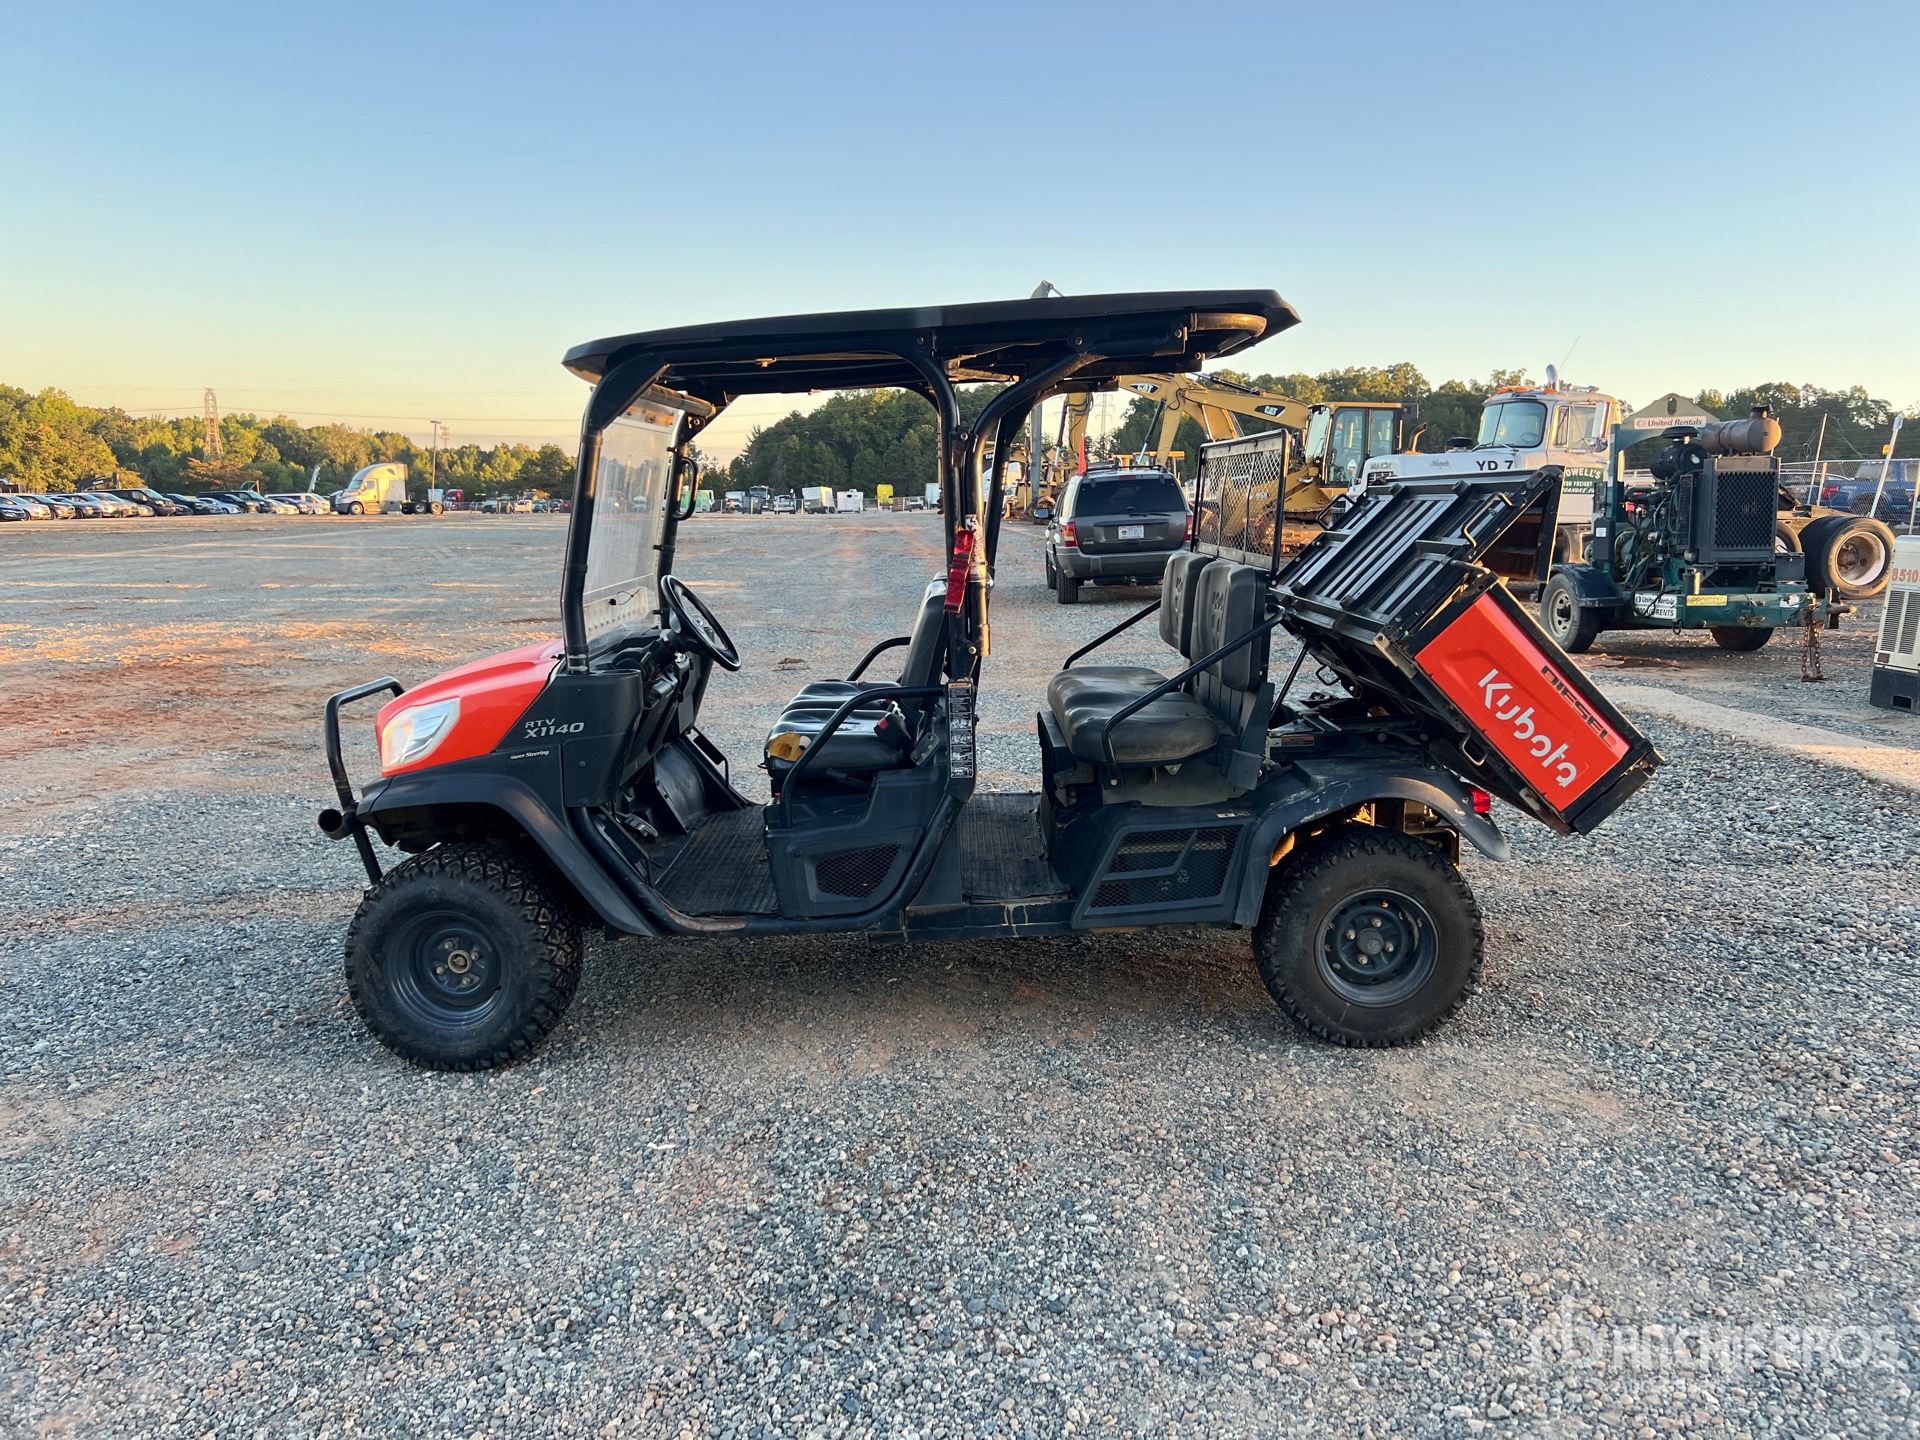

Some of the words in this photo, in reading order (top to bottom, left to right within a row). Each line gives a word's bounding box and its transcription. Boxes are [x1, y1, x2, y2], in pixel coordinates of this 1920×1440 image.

[1136, 383, 1154, 394] CAT
[1264, 405, 1278, 415] CAT
[1647, 419, 1673, 427] United
[1674, 418, 1702, 426] Rentals
[1475, 460, 1499, 471] YD
[1504, 460, 1514, 470] 7
[1565, 467, 1601, 479] OWELL'S
[1541, 665, 1617, 749] DIESEL
[524, 718, 556, 729] RTV
[1478, 668, 1578, 788] Kubota
[524, 722, 585, 739] X1140
